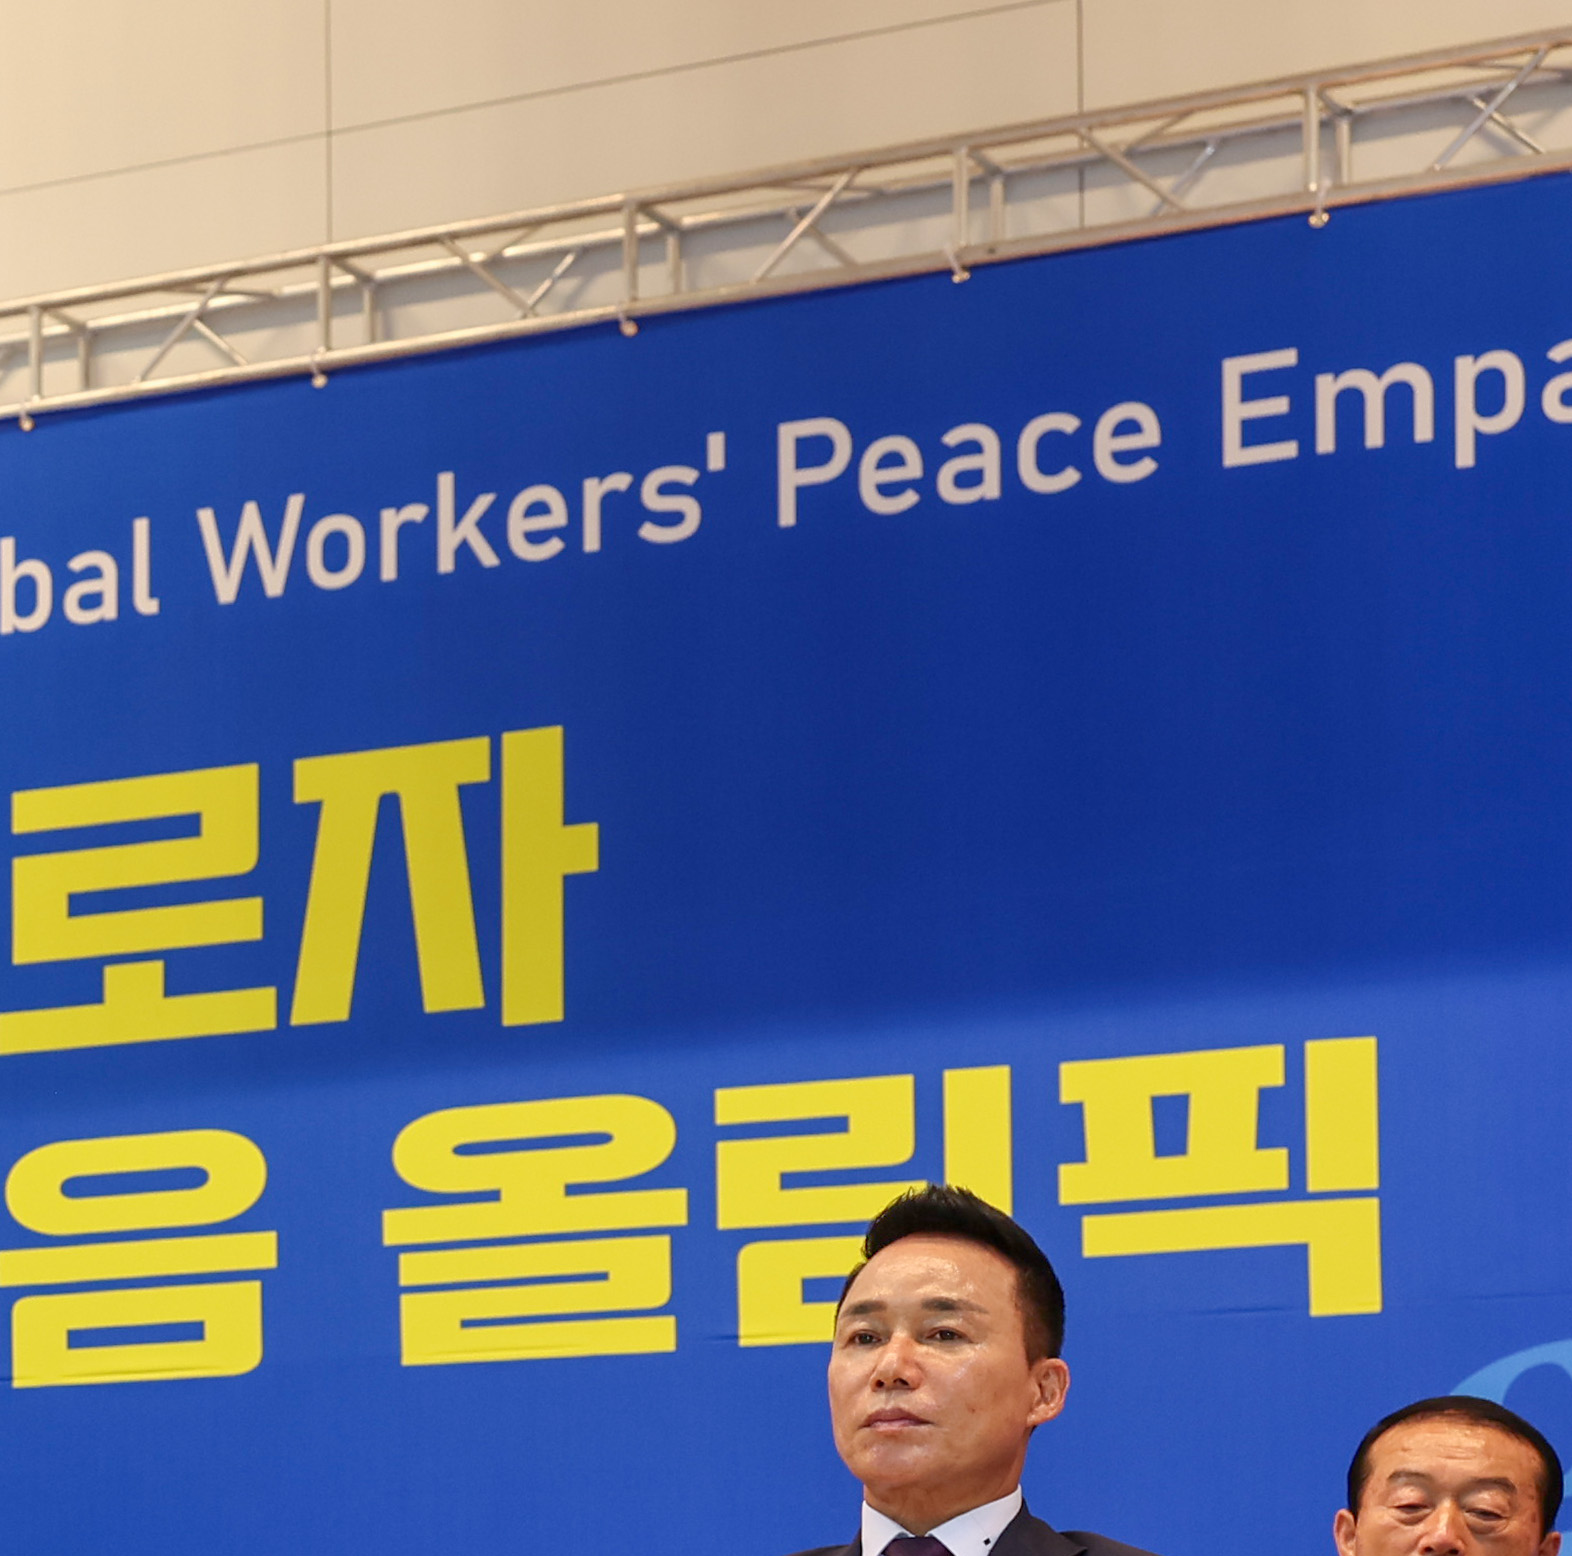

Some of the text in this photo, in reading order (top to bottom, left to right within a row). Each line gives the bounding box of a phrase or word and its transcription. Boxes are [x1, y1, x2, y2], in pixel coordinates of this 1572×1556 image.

[196, 430, 727, 606] Workers'
[776, 400, 1162, 528] Peace
[381, 1035, 1382, 1367] 올림픽
